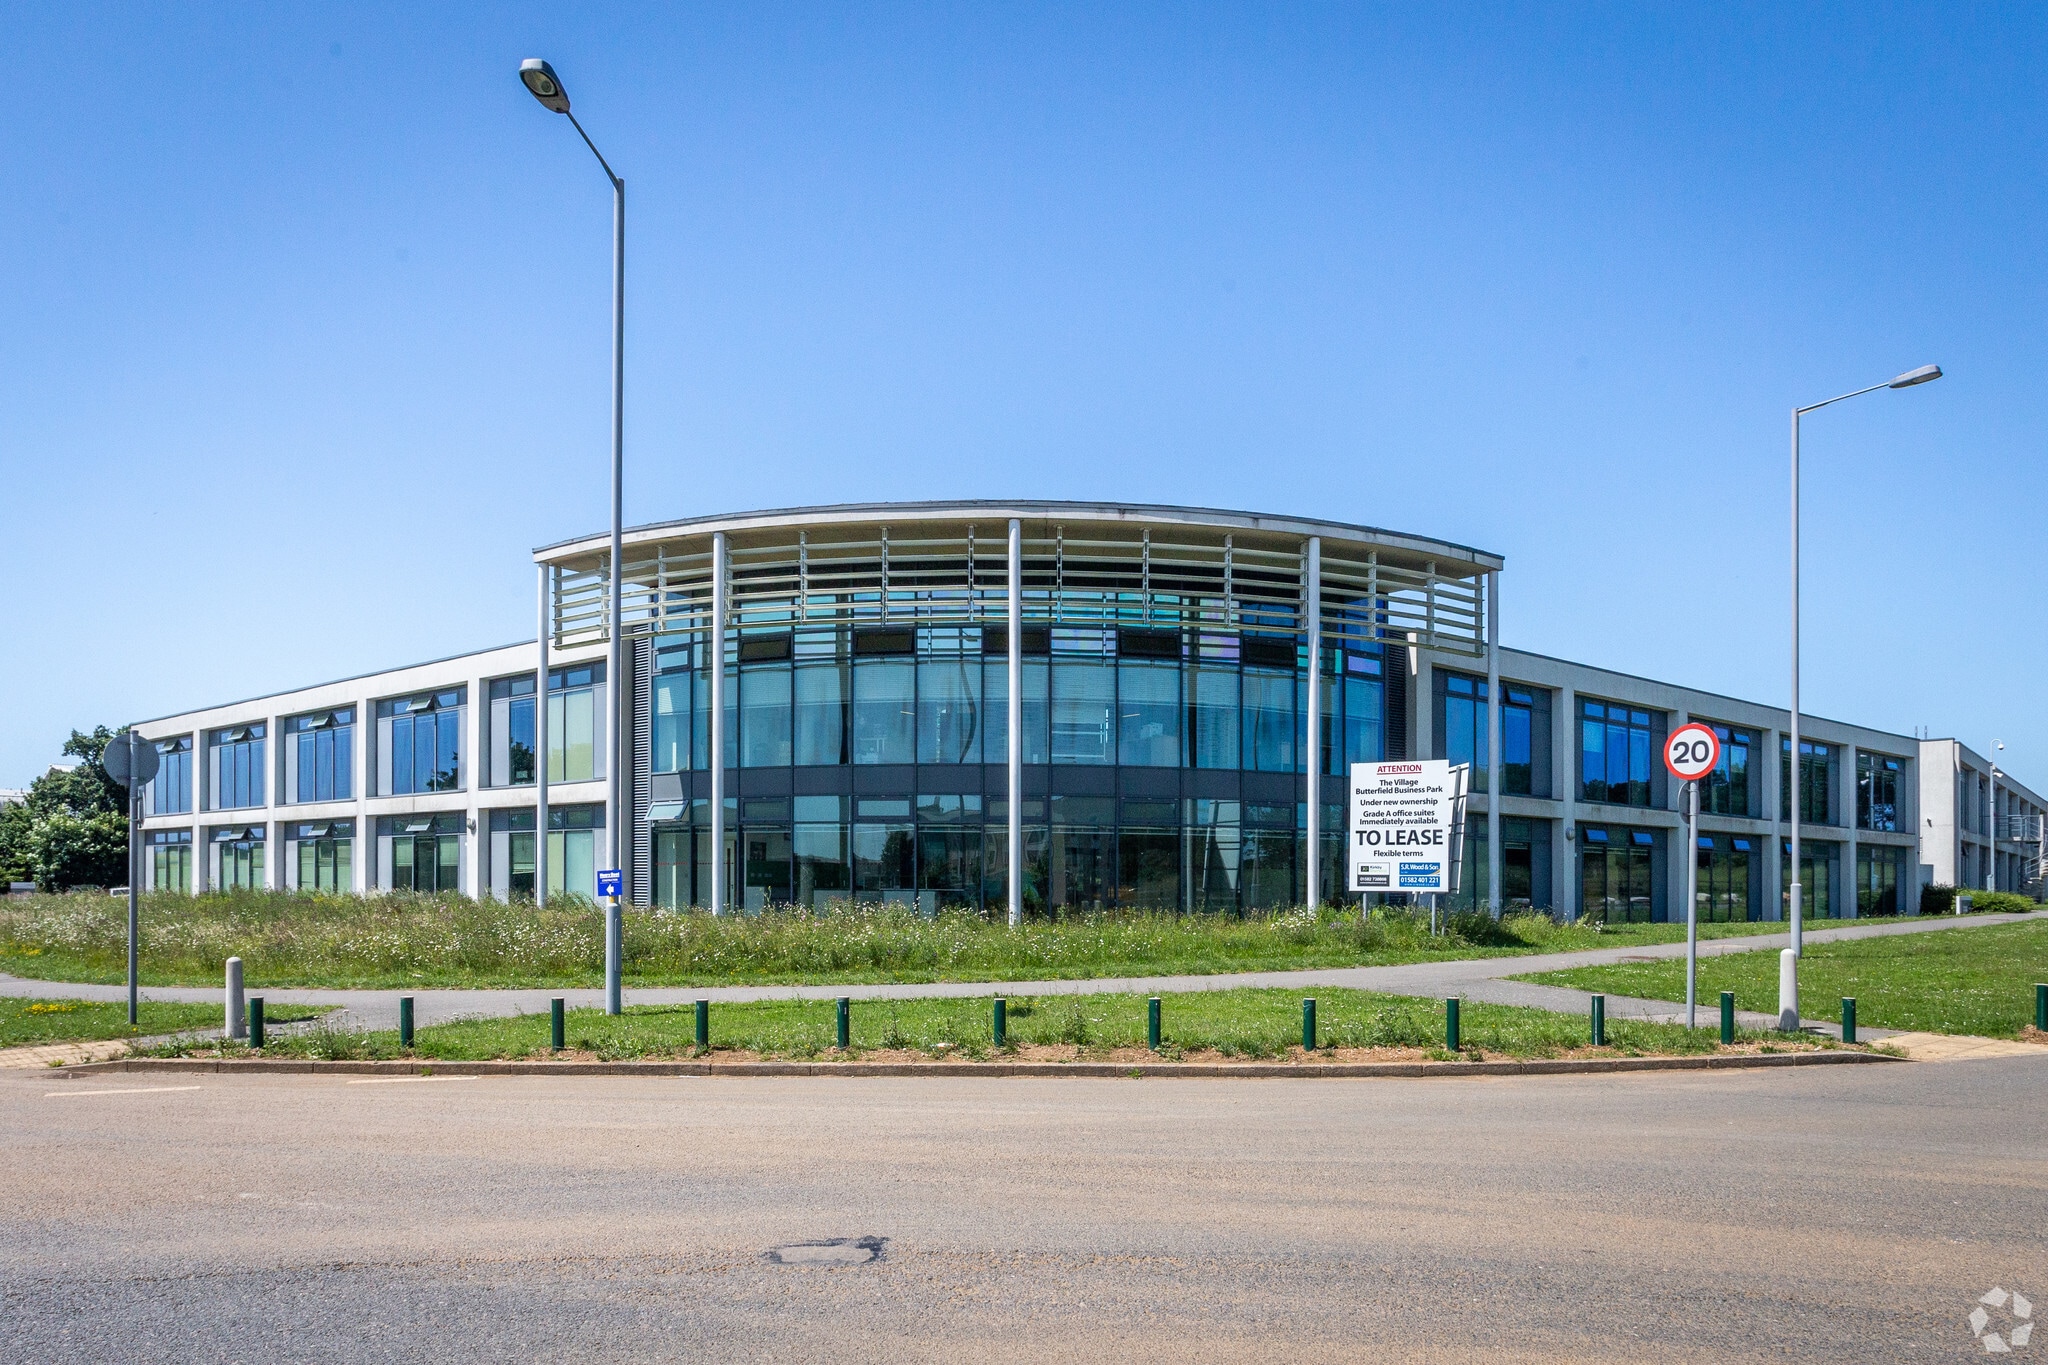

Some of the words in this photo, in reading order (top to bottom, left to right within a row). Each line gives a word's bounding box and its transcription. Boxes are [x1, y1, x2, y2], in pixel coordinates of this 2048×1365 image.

[1673, 740, 1709, 764] 20
[1377, 764, 1422, 772] ATTENTION
[1394, 779, 1418, 787] Village
[1394, 786, 1425, 794] Business
[1399, 798, 1438, 806] ownership
[1359, 818, 1404, 826] Immediately
[1405, 817, 1438, 825] available
[1355, 830, 1381, 846] TO
[1385, 829, 1443, 846] LEASE
